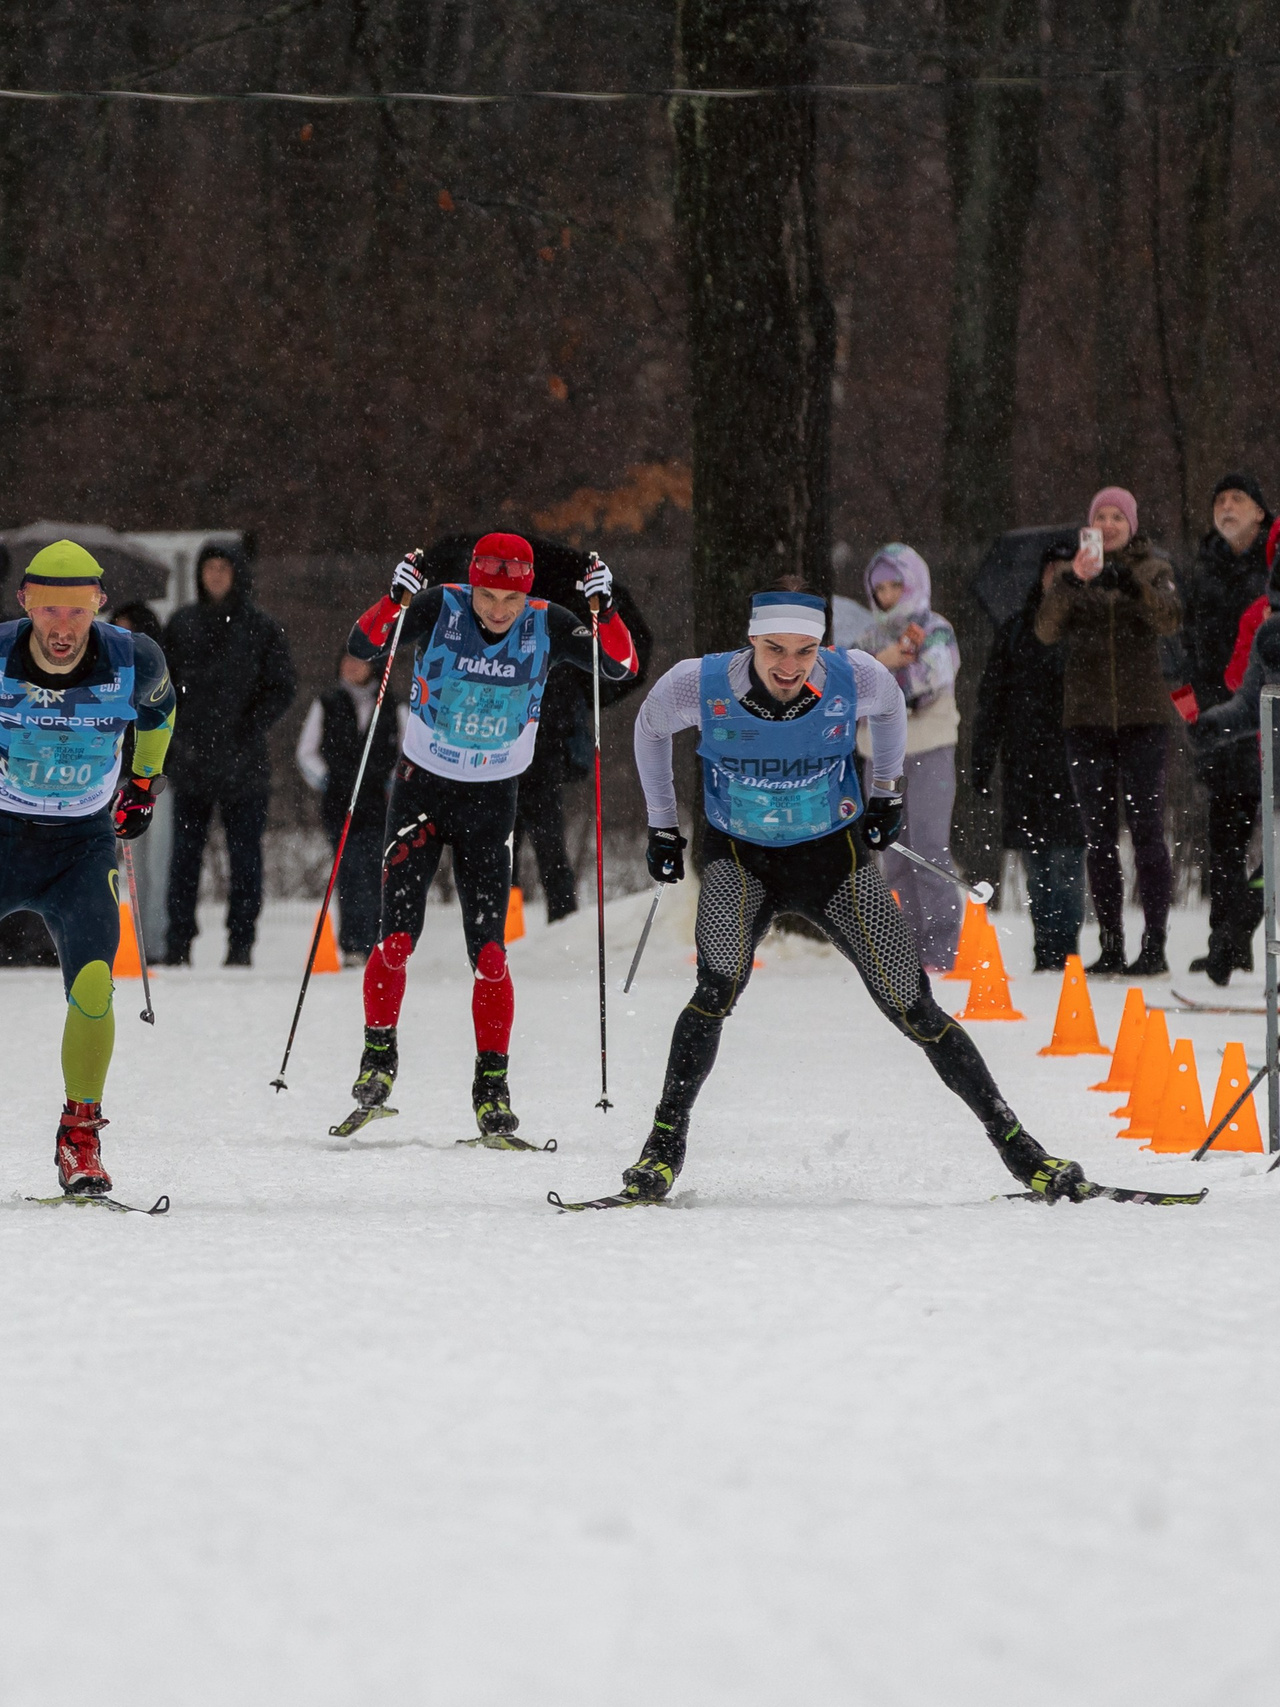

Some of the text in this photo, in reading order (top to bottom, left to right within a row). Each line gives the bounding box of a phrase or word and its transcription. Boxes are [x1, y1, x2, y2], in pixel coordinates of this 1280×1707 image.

[521, 645, 537, 654] CUP
[458, 656, 516, 678] rukka
[99, 684, 121, 693] CUP
[25, 716, 114, 727] NORDSKI
[452, 711, 508, 738] 1850
[722, 754, 842, 778] СПРИНТ
[655, 830, 677, 841] SWIX
